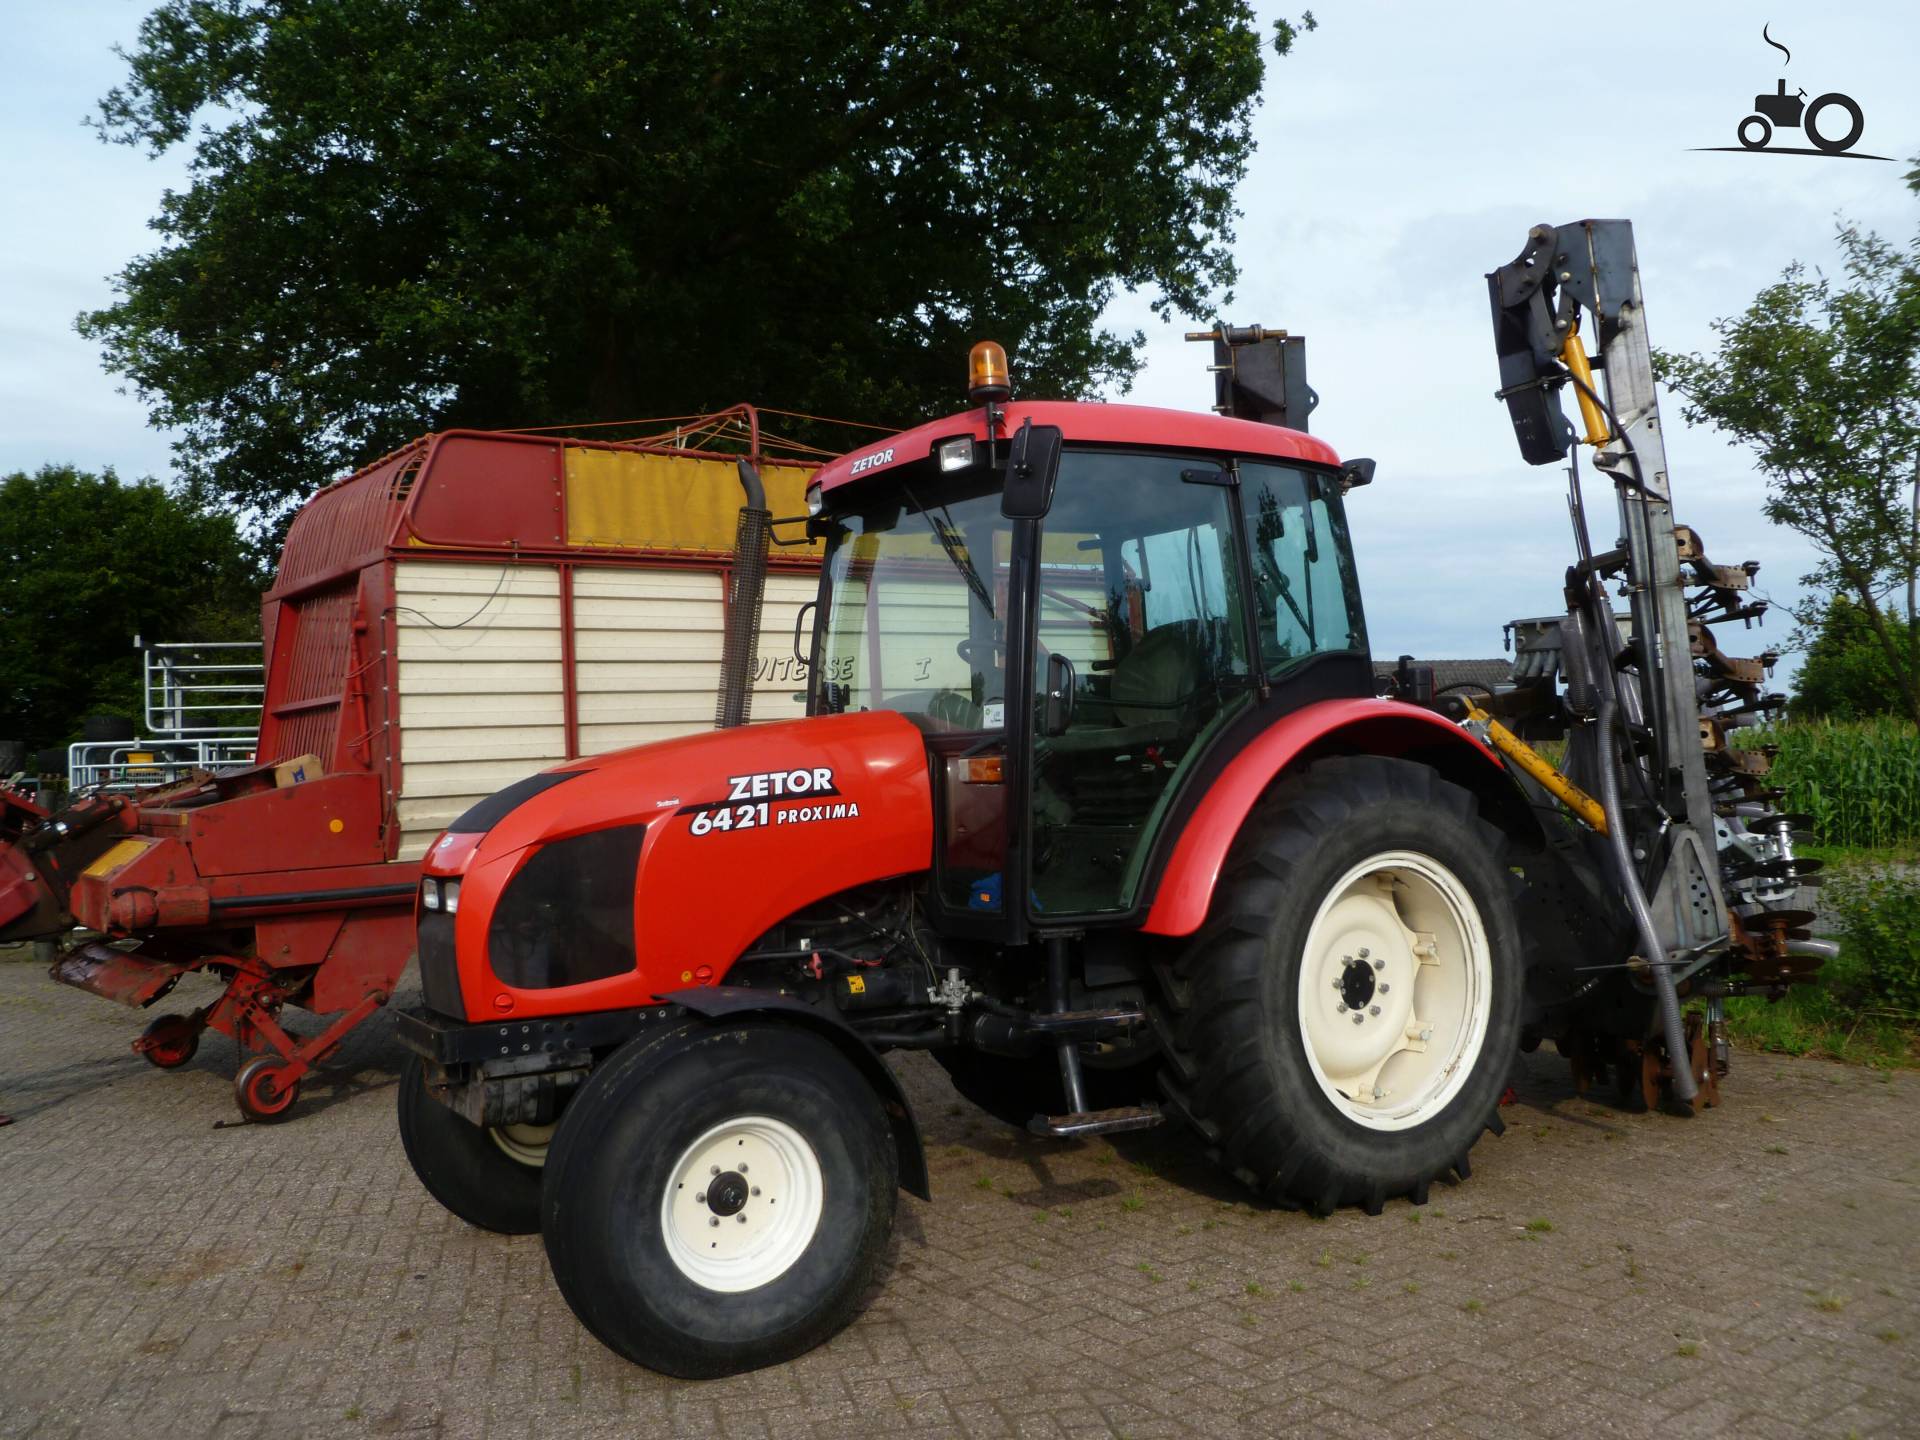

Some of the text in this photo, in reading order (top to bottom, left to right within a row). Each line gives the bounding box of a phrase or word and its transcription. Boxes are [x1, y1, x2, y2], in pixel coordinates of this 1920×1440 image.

[850, 448, 894, 475] ZETOR
[751, 656, 855, 681] VITESE
[728, 768, 833, 801] ZETOR
[690, 803, 859, 836] 6421 PROXIMA
